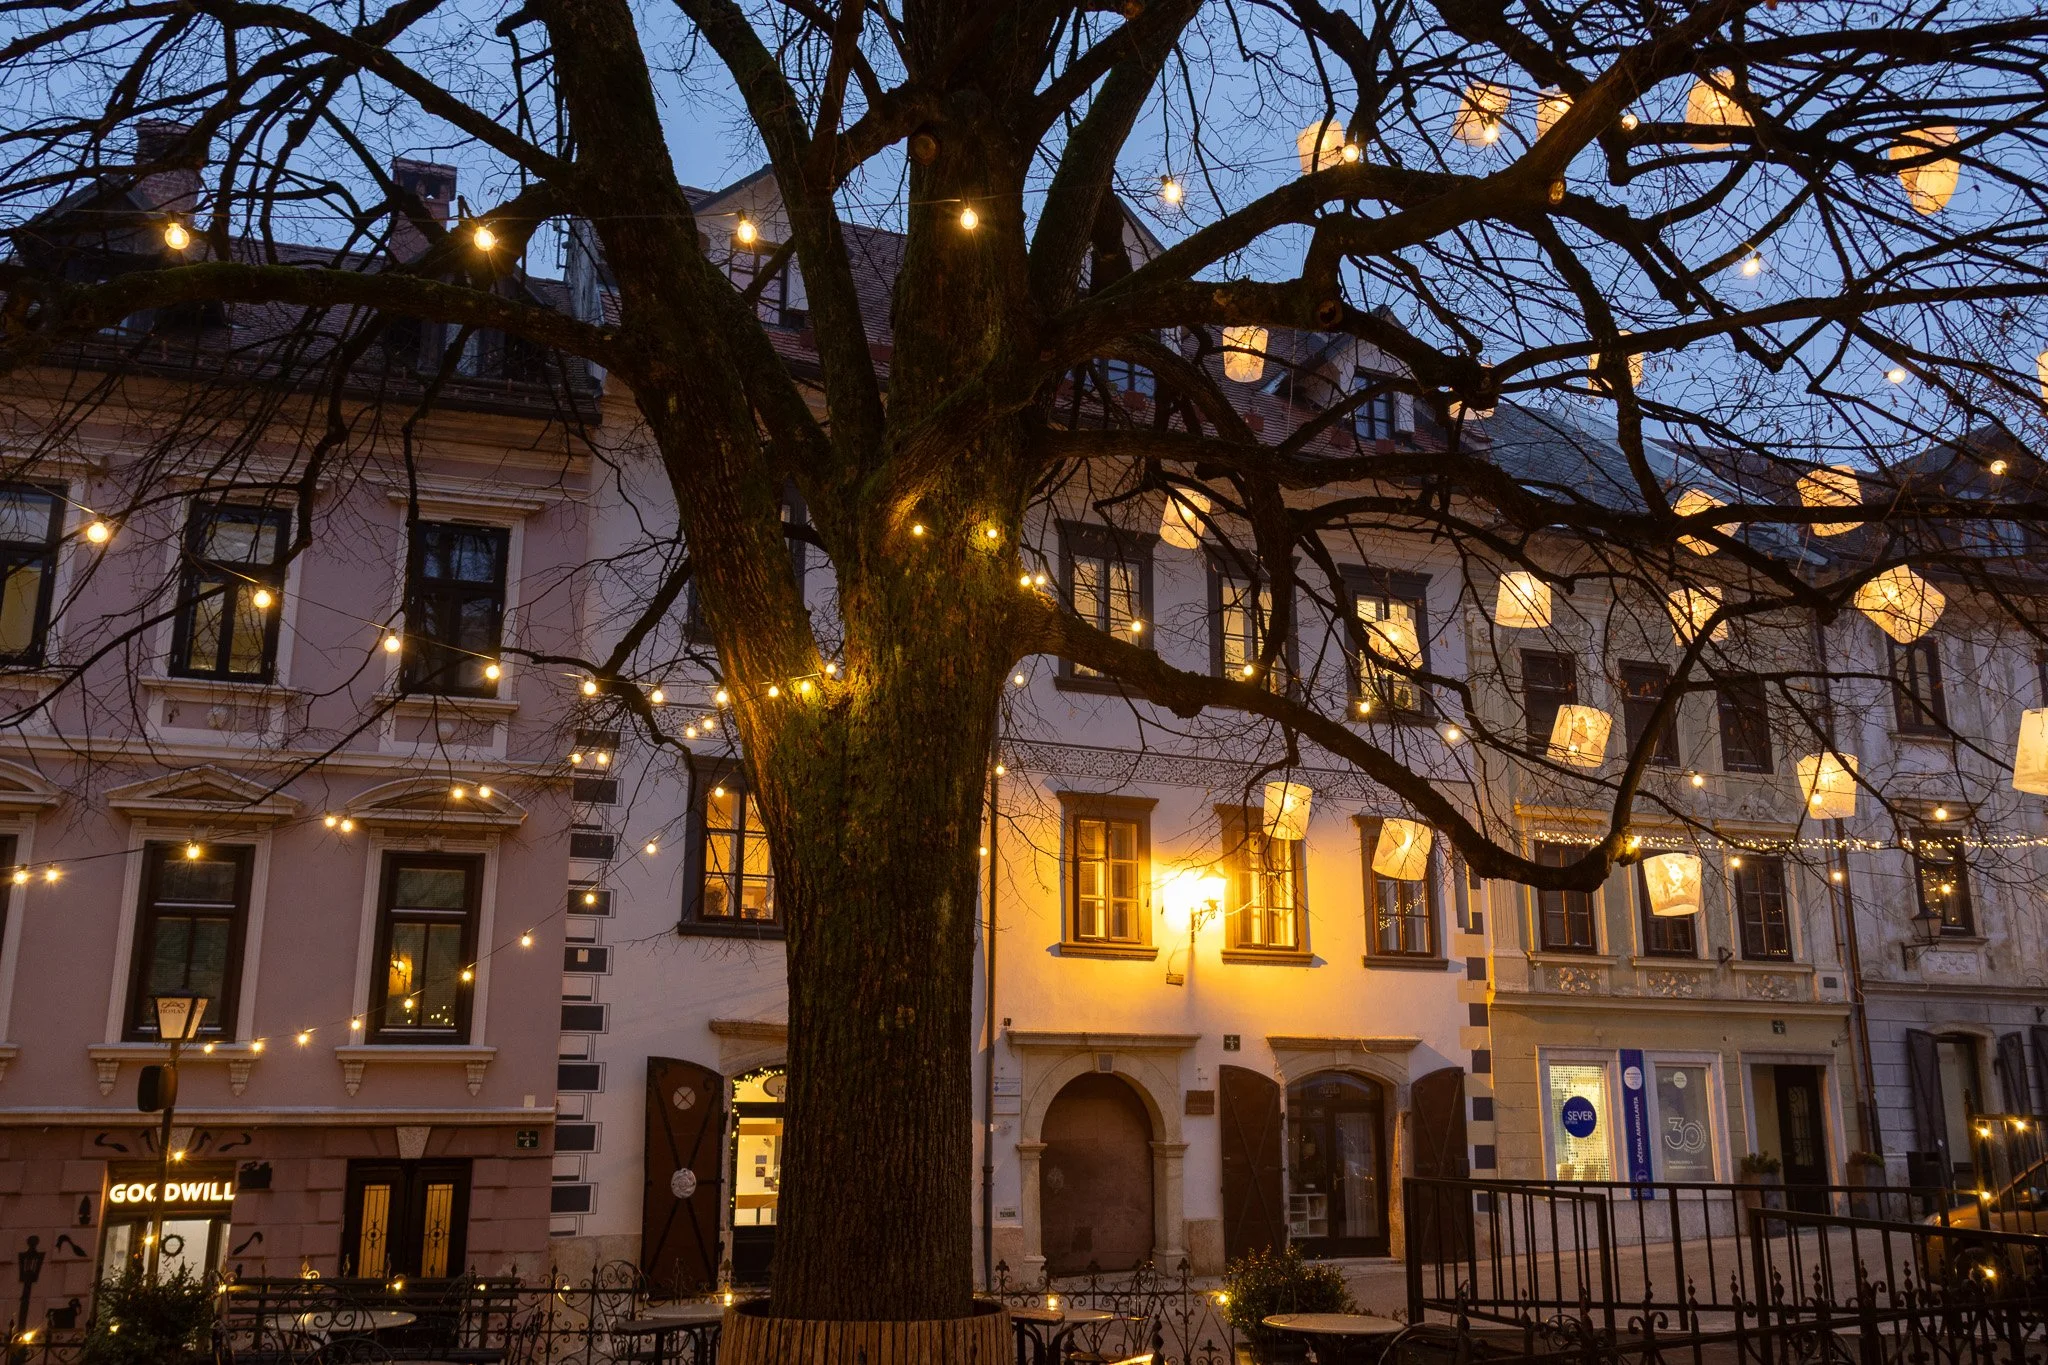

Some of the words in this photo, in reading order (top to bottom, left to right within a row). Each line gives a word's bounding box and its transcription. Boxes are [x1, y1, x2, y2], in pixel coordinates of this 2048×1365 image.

[1567, 1110, 1593, 1121] SEVER
[1633, 1096, 1642, 1137] AMBULANTA
[1665, 1117, 1702, 1150] 30
[109, 1182, 236, 1203] GOODWILL
